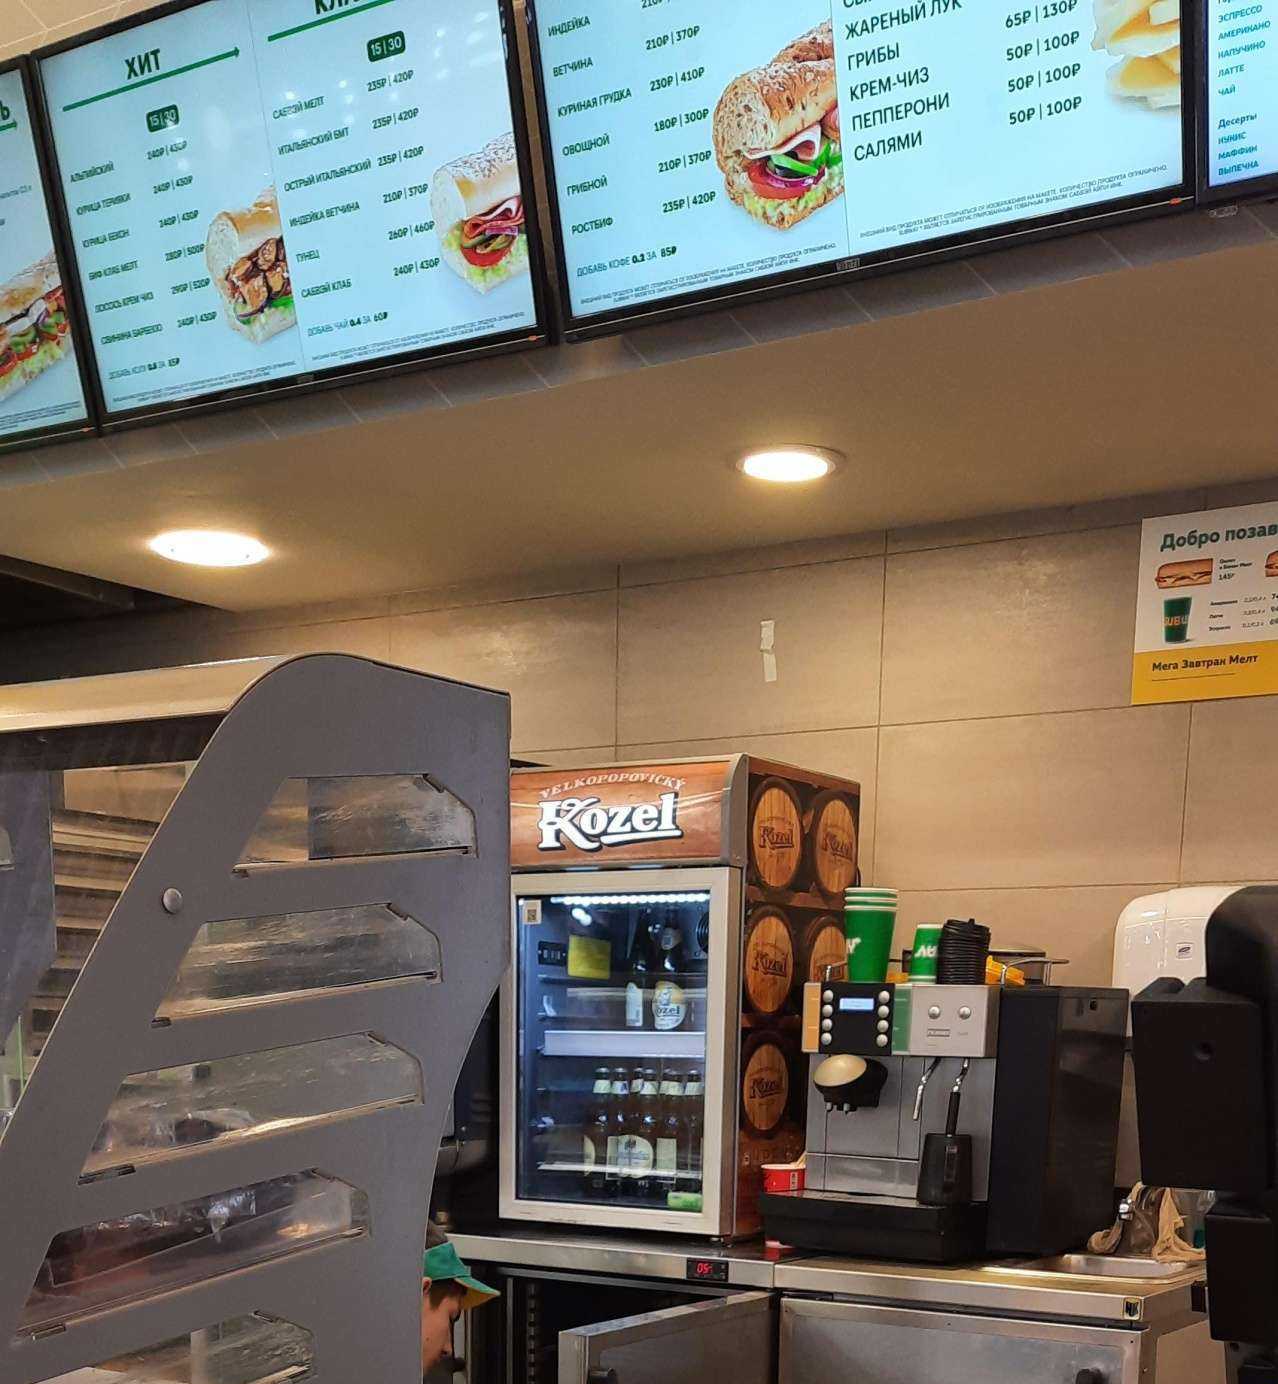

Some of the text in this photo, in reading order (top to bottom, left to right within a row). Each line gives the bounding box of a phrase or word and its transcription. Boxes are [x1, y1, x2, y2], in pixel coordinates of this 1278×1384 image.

[845, 0, 926, 40] ЖАРЕНЫЙ
[1218, 5, 1263, 23] ЭСПРЕССО
[548, 16, 590, 37] ИНДЕЙКА
[125, 49, 160, 80] ХИТ
[553, 57, 593, 77] ВЕТЧИНА
[847, 42, 900, 71] ГРИБЫ
[1218, 64, 1245, 77] ЛАТТЕ
[850, 66, 930, 102] КРЕМ-ЧИЗ
[1218, 84, 1236, 96] ЧАЙ
[558, 97, 598, 117] КУРИНАЯ
[599, 88, 632, 106] ГРУДКА
[852, 92, 950, 132] ПЕППЕРОНИ
[1218, 114, 1257, 129] Десерты
[562, 133, 610, 156] ОВОЩНОЙ
[854, 130, 923, 161] САЛЯМИ
[566, 174, 608, 196] ГРИБНОЙ
[571, 217, 614, 235] РОСТБИФ
[1160, 530, 1220, 552] Добро
[1152, 659, 1179, 672] Мега
[1229, 654, 1259, 666] Мелт
[537, 791, 684, 852] Kozel
